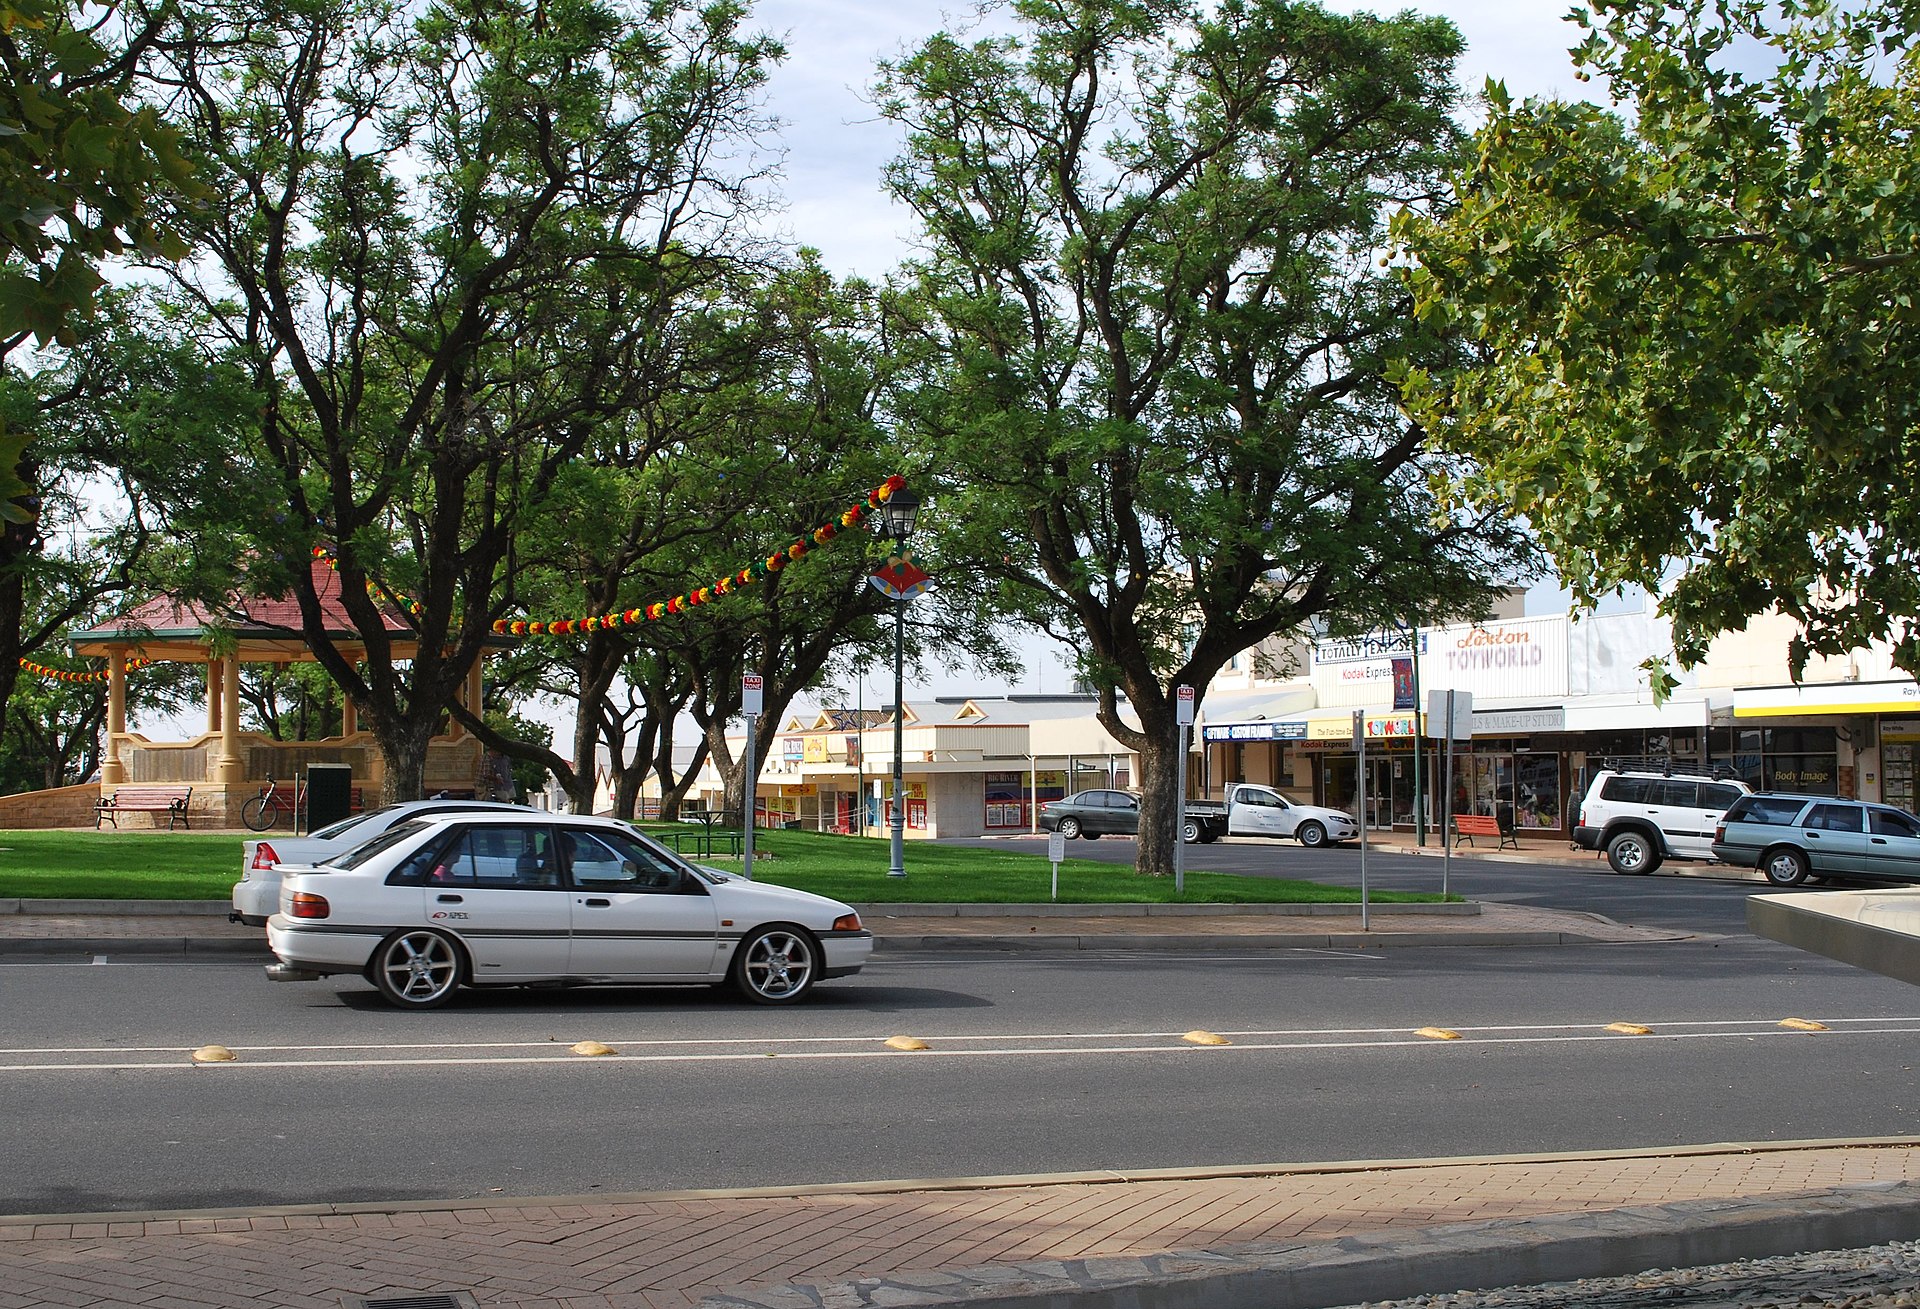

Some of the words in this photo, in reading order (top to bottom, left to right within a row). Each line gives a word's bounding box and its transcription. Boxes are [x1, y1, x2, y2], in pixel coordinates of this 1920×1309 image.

[1457, 627, 1530, 648] Loxton
[1321, 645, 1361, 659] TOTALLY
[1446, 644, 1542, 671] TOYWORLD
[1342, 668, 1365, 680] Kodak
[1903, 687, 1917, 697] Ray
[1367, 719, 1416, 736] TOYWORL
[1484, 717, 1492, 729] &
[1492, 715, 1531, 728] MAKE-UP
[1533, 713, 1562, 727] STUDIO
[1323, 741, 1349, 749] Express
[988, 773, 999, 782] BIG
[1001, 773, 1019, 782] RIVER
[1775, 771, 1797, 782] Body
[1801, 770, 1829, 782] Image
